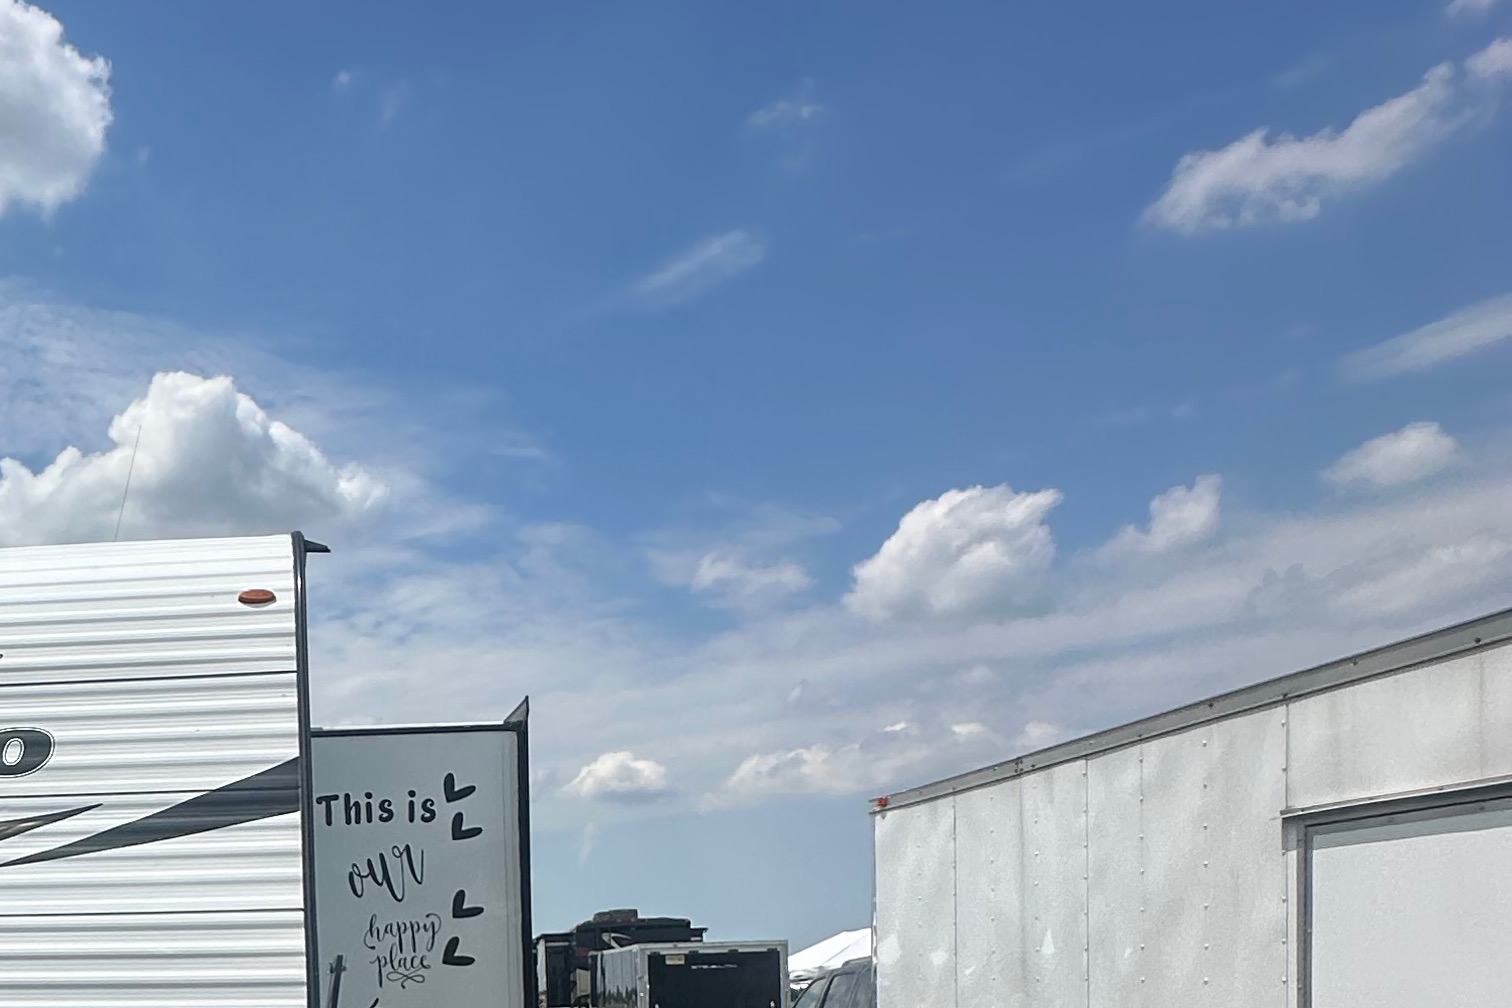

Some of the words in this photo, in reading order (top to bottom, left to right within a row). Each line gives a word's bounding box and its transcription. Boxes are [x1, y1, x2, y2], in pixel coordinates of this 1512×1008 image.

[316, 791, 394, 826] This
[407, 789, 436, 823] is
[348, 843, 424, 902] our
[364, 913, 442, 954] happy
[369, 943, 431, 988] place
